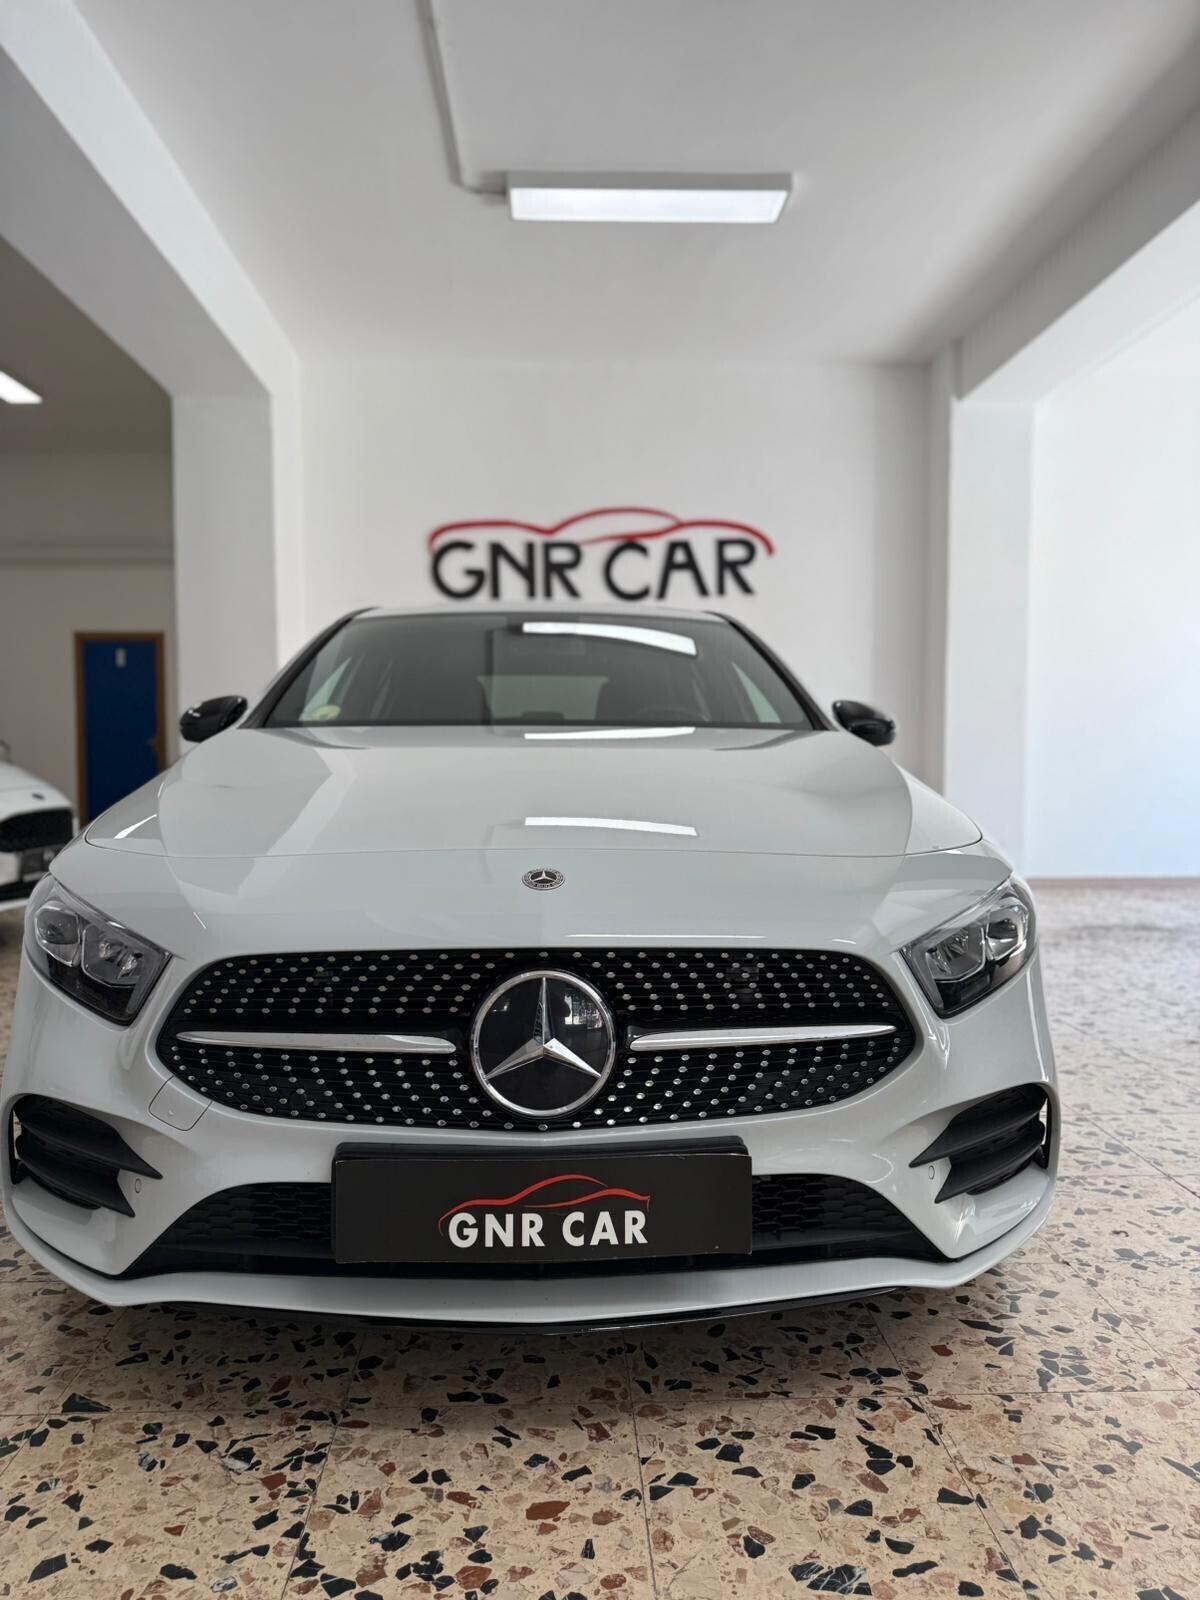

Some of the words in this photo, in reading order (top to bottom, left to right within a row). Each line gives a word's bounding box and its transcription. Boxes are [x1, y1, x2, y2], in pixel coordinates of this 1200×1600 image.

[432, 541, 582, 599] GNR
[604, 539, 755, 601] CAR
[449, 1213, 544, 1247] GNR
[563, 1210, 647, 1246] CAR
